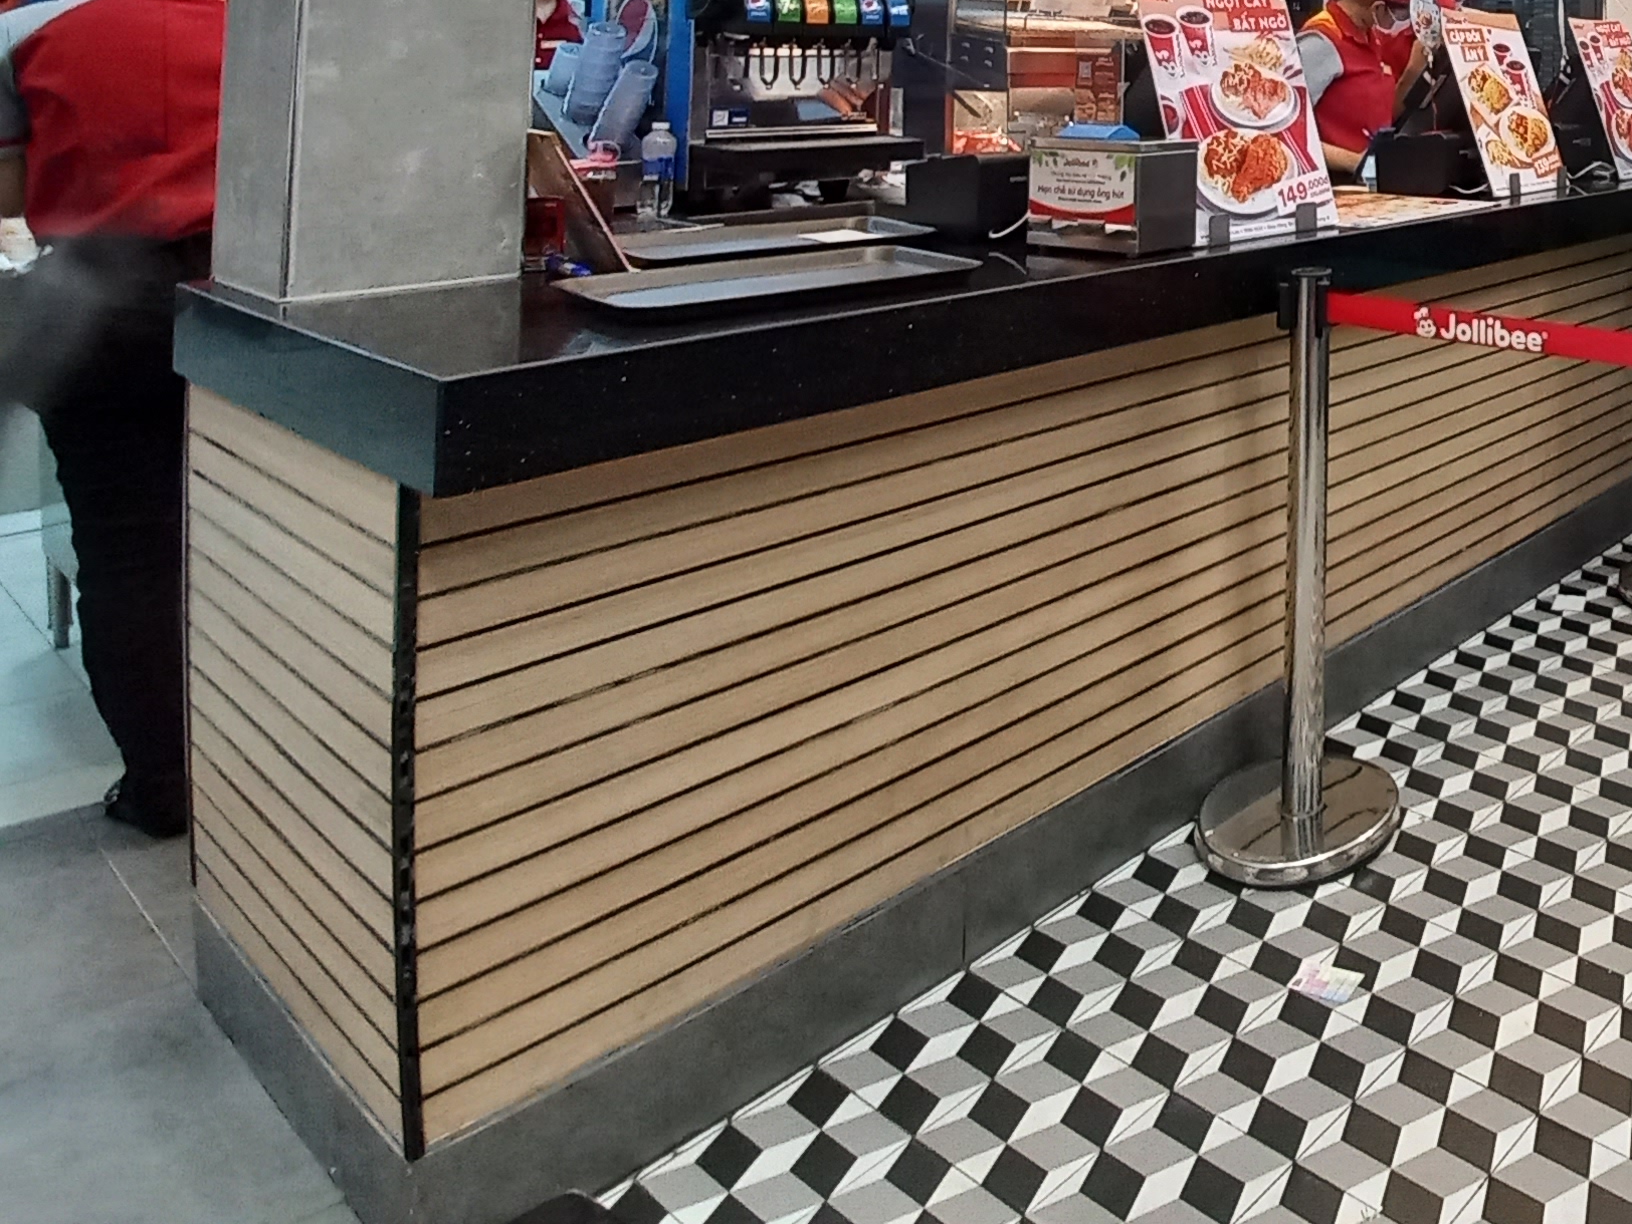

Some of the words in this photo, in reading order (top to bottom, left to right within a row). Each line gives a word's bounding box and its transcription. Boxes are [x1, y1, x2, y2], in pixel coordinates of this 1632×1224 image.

[1233, 12, 1256, 30] BẤT
[1259, 12, 1287, 29] NGỜ
[1440, 313, 1544, 353] Jollibee
